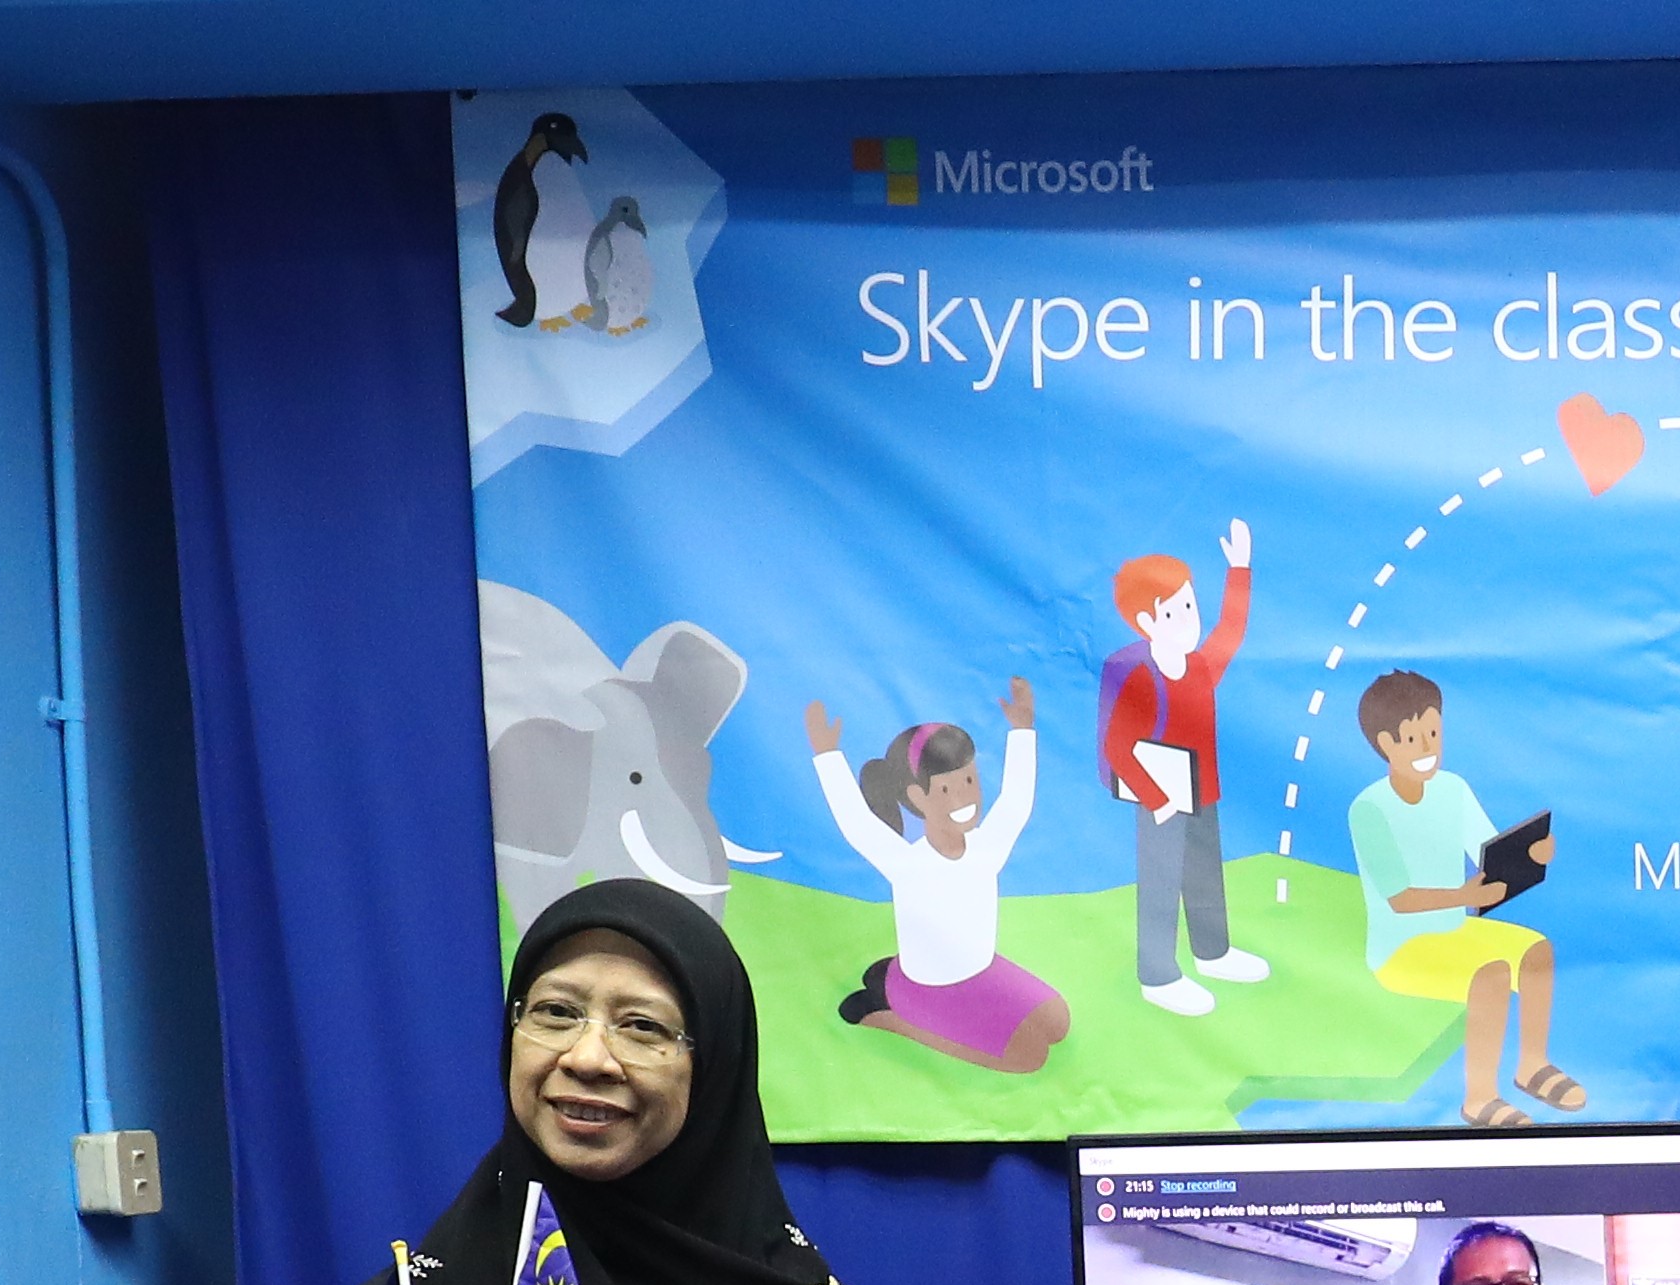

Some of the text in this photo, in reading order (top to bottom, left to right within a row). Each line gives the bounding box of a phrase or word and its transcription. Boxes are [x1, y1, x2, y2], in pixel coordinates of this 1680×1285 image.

[933, 145, 1154, 195] Microsoft
[858, 269, 1151, 391] Skype
[1189, 276, 1264, 361] in
[1300, 274, 1457, 362] the
[1125, 1179, 1236, 1193] 21:15 Stop recording
[1123, 1206, 1160, 1220] Mighty
[1161, 1206, 1171, 1218] is
[1173, 1206, 1201, 1220] using
[1212, 1204, 1245, 1217] device
[1247, 1204, 1269, 1216] that
[1270, 1203, 1299, 1215] could
[1301, 1202, 1335, 1215] record
[1337, 1204, 1349, 1214] or
[1351, 1201, 1403, 1214] broadcast
[1404, 1201, 1423, 1213] this
[1424, 1200, 1445, 1213] call.
